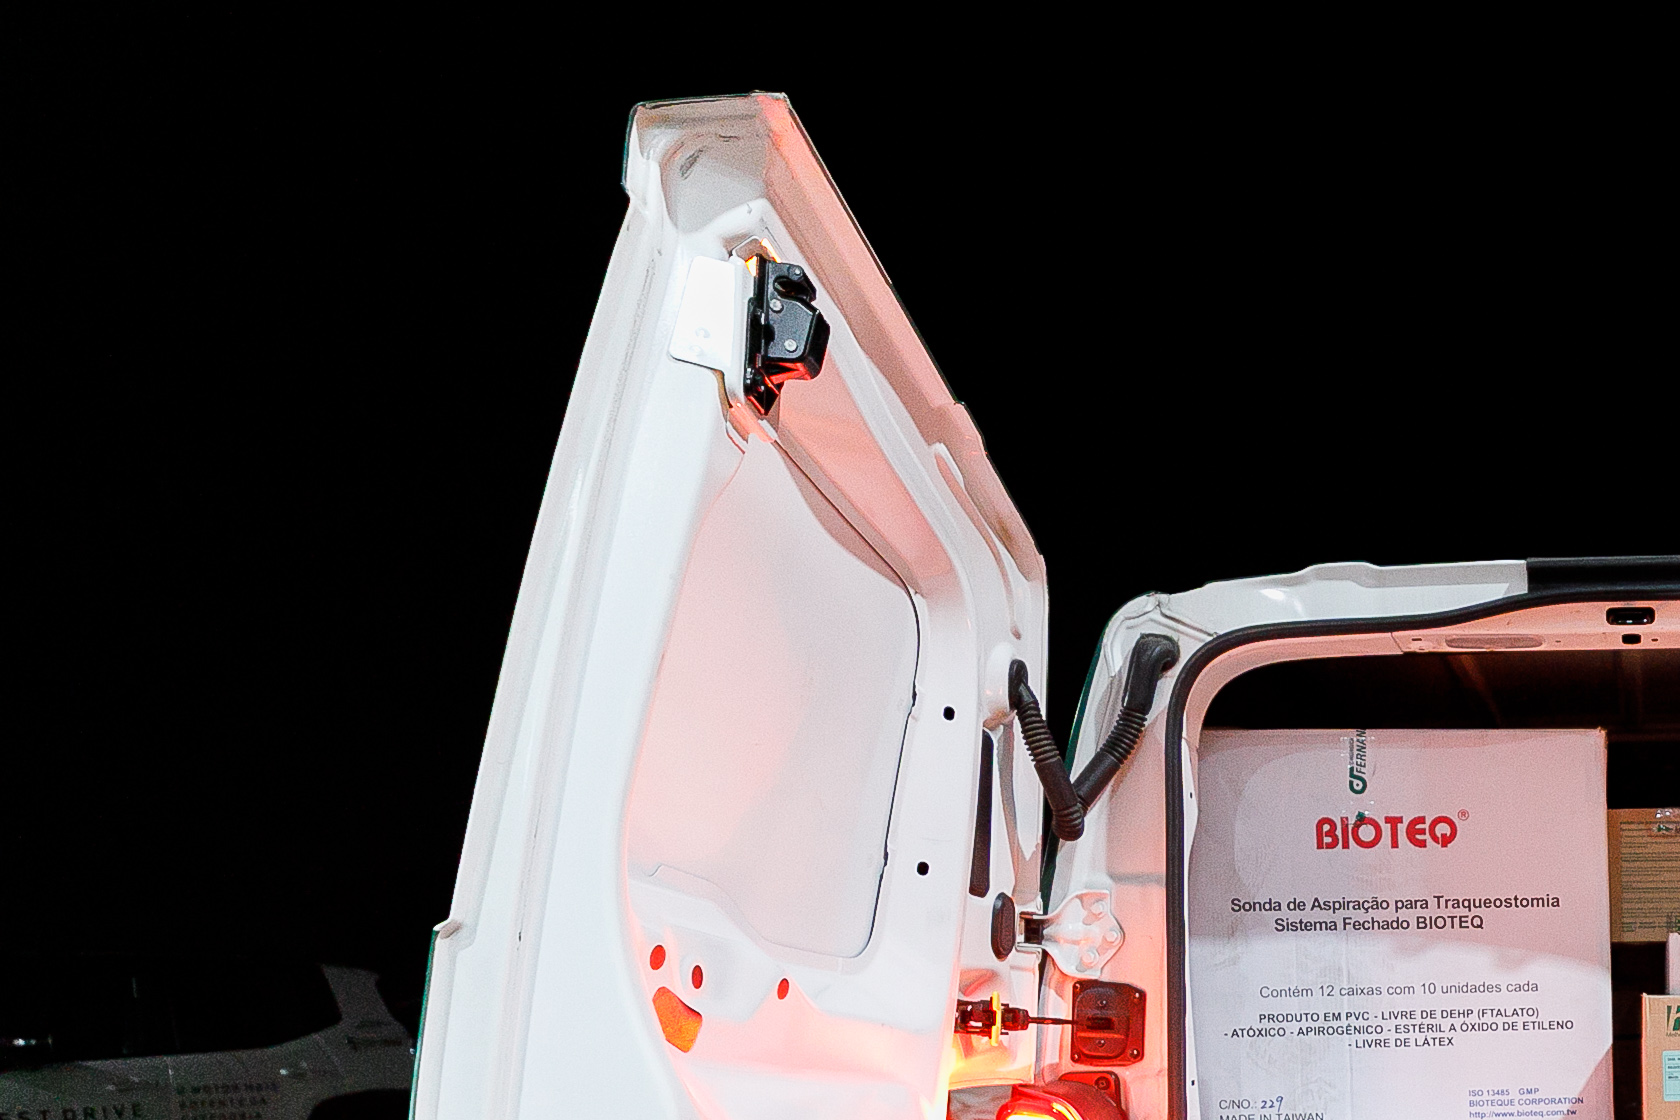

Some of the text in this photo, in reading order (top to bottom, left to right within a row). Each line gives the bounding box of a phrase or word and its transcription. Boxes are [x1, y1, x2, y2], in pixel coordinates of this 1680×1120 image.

[1316, 815, 1458, 849] BIOTEQ
[1231, 894, 1560, 914] Sonda de Aspiração para Traqueostomia
[1274, 915, 1484, 932] Sistema Fechado BIOTEQ
[1259, 981, 1539, 998] Contém 12 caixas com 10 unidades cada
[1259, 1007, 1539, 1023] PRODUTO EM PVC LIVRE DE DEHP (FTALATO)
[1231, 1020, 1574, 1038] ATÓXICO APIROGÊNICO ESTÉRIL A ÓXIDO DE ETILENO
[1355, 1035, 1454, 1048] LIVRE DE LÁTEX
[1469, 1089, 1484, 1097] ISO
[1260, 1096, 1284, 1113] 229
[1469, 1097, 1584, 1107] BIOTEQUE CORPORATION
